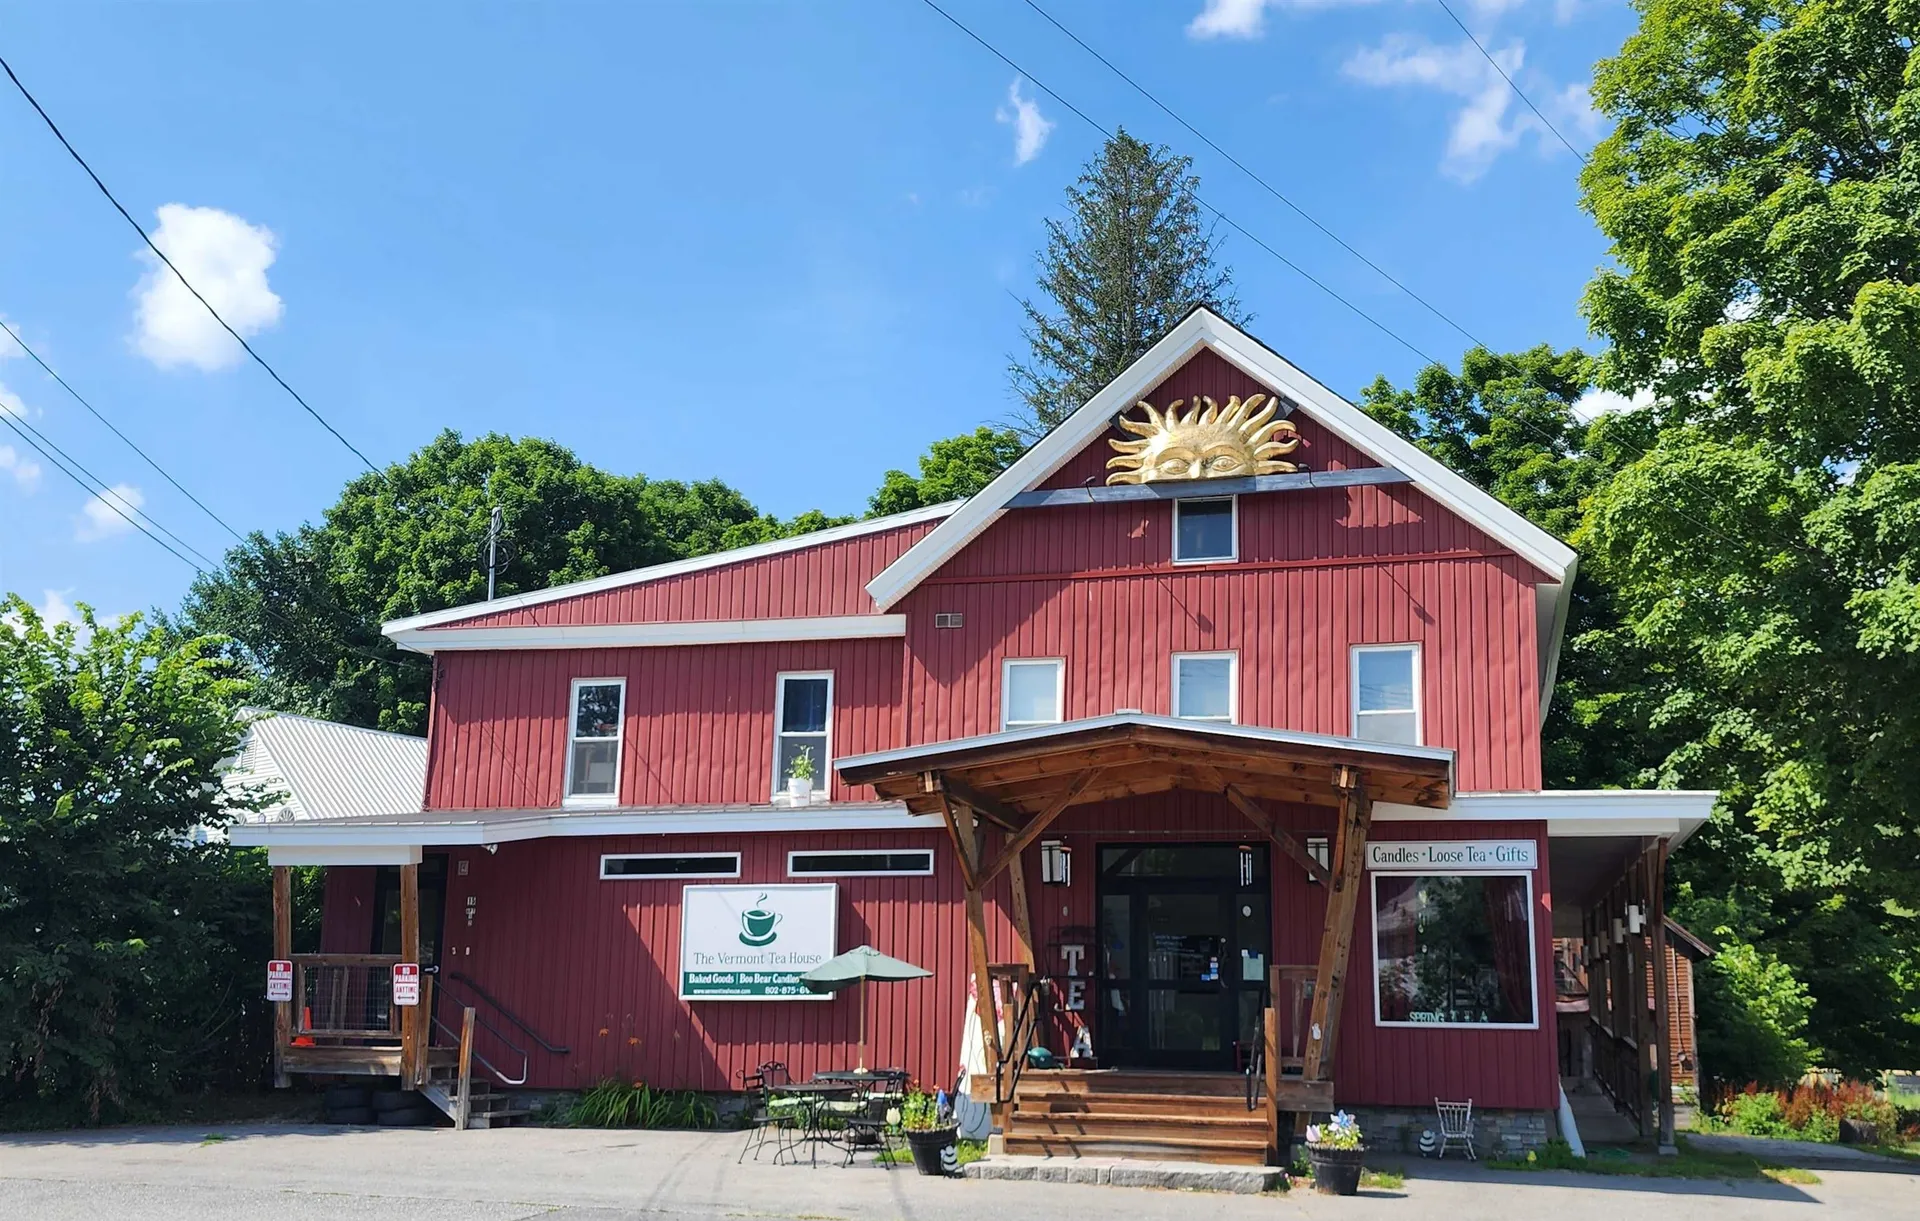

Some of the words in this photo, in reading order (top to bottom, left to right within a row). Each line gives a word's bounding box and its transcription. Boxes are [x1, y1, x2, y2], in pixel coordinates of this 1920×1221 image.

[1373, 846, 1419, 863] Candles
[1428, 846, 1464, 863] Loose
[1466, 845, 1486, 862] Tea
[1496, 845, 1529, 862] Gifts
[694, 952, 715, 965] The
[717, 952, 765, 965] Vermont
[768, 952, 786, 964] Tea
[789, 951, 822, 964] House
[689, 973, 712, 984] Baked
[712, 973, 735, 984] Goods
[740, 973, 754, 984] Boo
[754, 973, 772, 984] Bear
[772, 973, 800, 984] Candles
